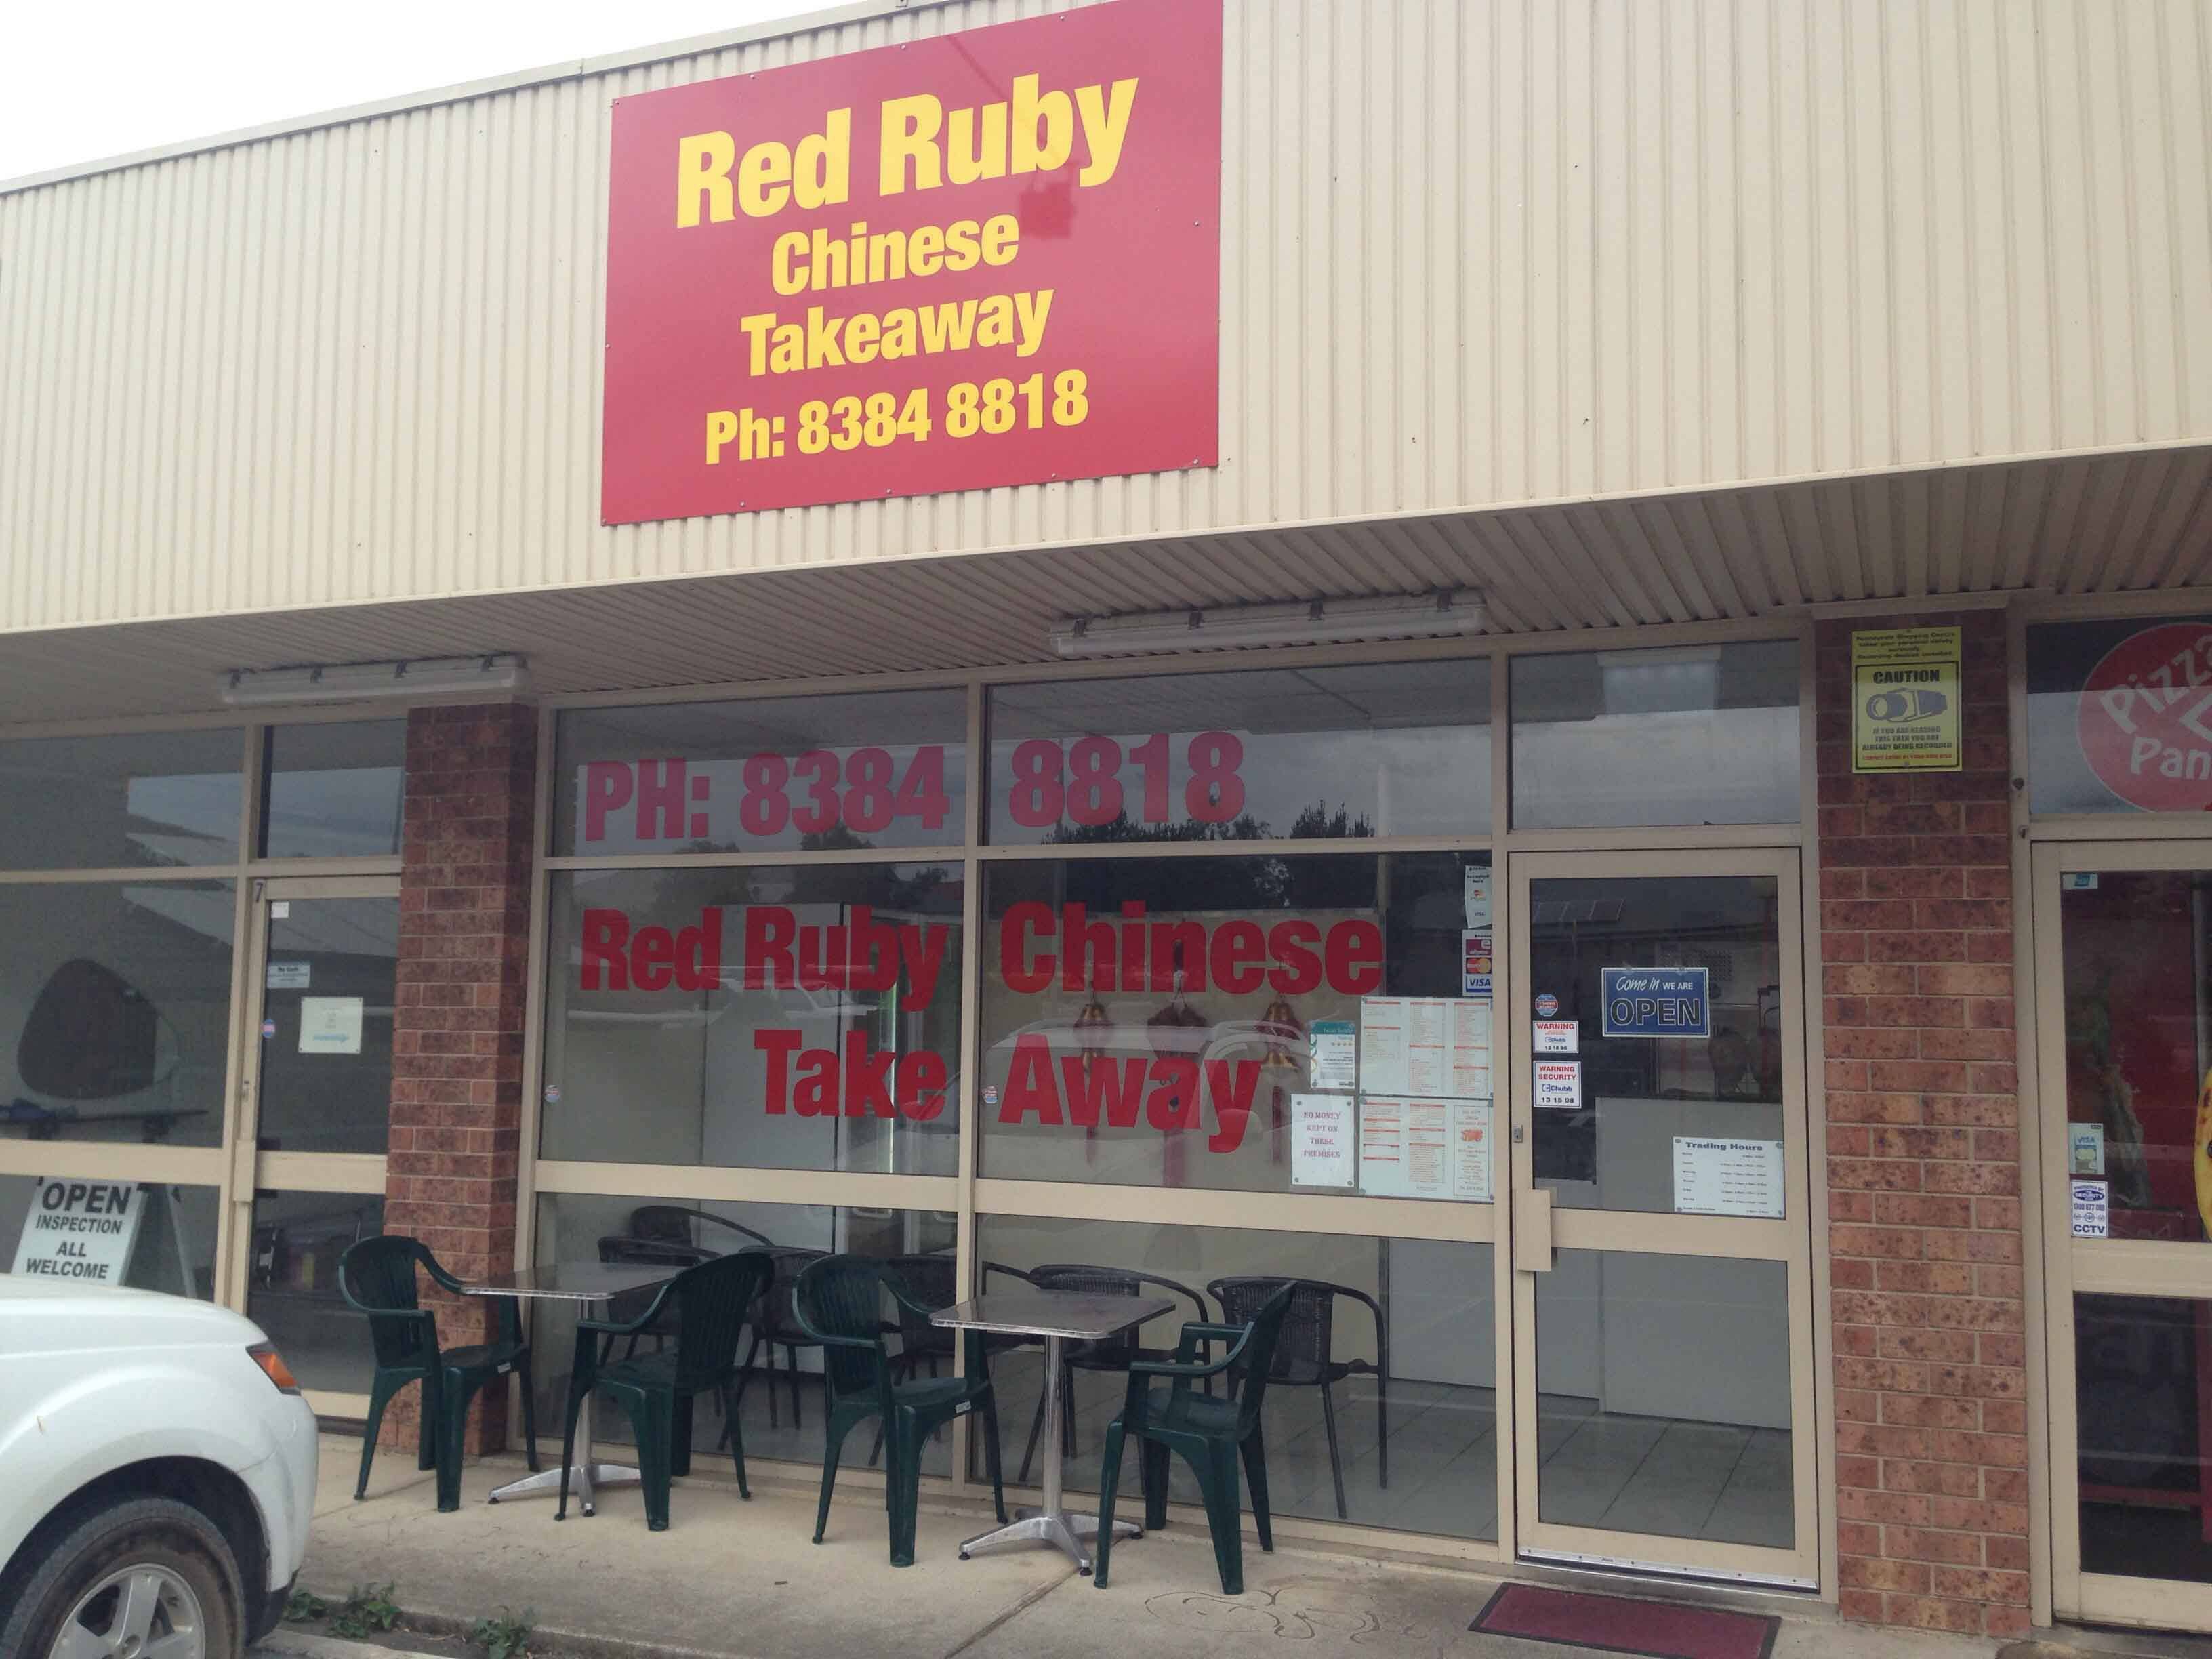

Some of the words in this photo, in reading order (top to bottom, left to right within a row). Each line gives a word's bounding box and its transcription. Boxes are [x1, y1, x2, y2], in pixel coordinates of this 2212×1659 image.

[677, 108, 851, 228] Red
[880, 73, 1139, 196] Ruby
[772, 213, 1019, 295] Chinese
[741, 289, 1054, 377] Takeaway
[705, 409, 785, 465] Ph:
[797, 388, 931, 454] 8384
[945, 369, 1088, 438] 8818
[1872, 670, 1940, 683] CAUTION
[585, 758, 710, 841] PH:
[740, 746, 951, 835] 8384
[1010, 731, 1245, 827] 8818
[255, 882, 264, 903] 7
[580, 907, 722, 991] Red
[743, 905, 948, 1011] Ruby
[1000, 900, 1384, 995] Chinese
[1469, 978, 1491, 987] VISA
[1616, 976, 1647, 991] Come
[1648, 976, 1660, 991] in
[1663, 982, 1676, 990] WE
[1677, 982, 1693, 990] ARE
[1610, 998, 1701, 1026] OPEN
[754, 1029, 947, 1120] Take
[998, 1034, 1262, 1153] Away
[1315, 1111, 1340, 1120] MONEY
[1685, 1142, 1727, 1151] Trading
[41, 1183, 131, 1214] OPEN
[35, 1215, 123, 1234] INSPECTION
[2074, 1225, 2105, 1234] CCTV
[56, 1241, 87, 1257] ALL
[26, 1258, 109, 1279] WELCOME
